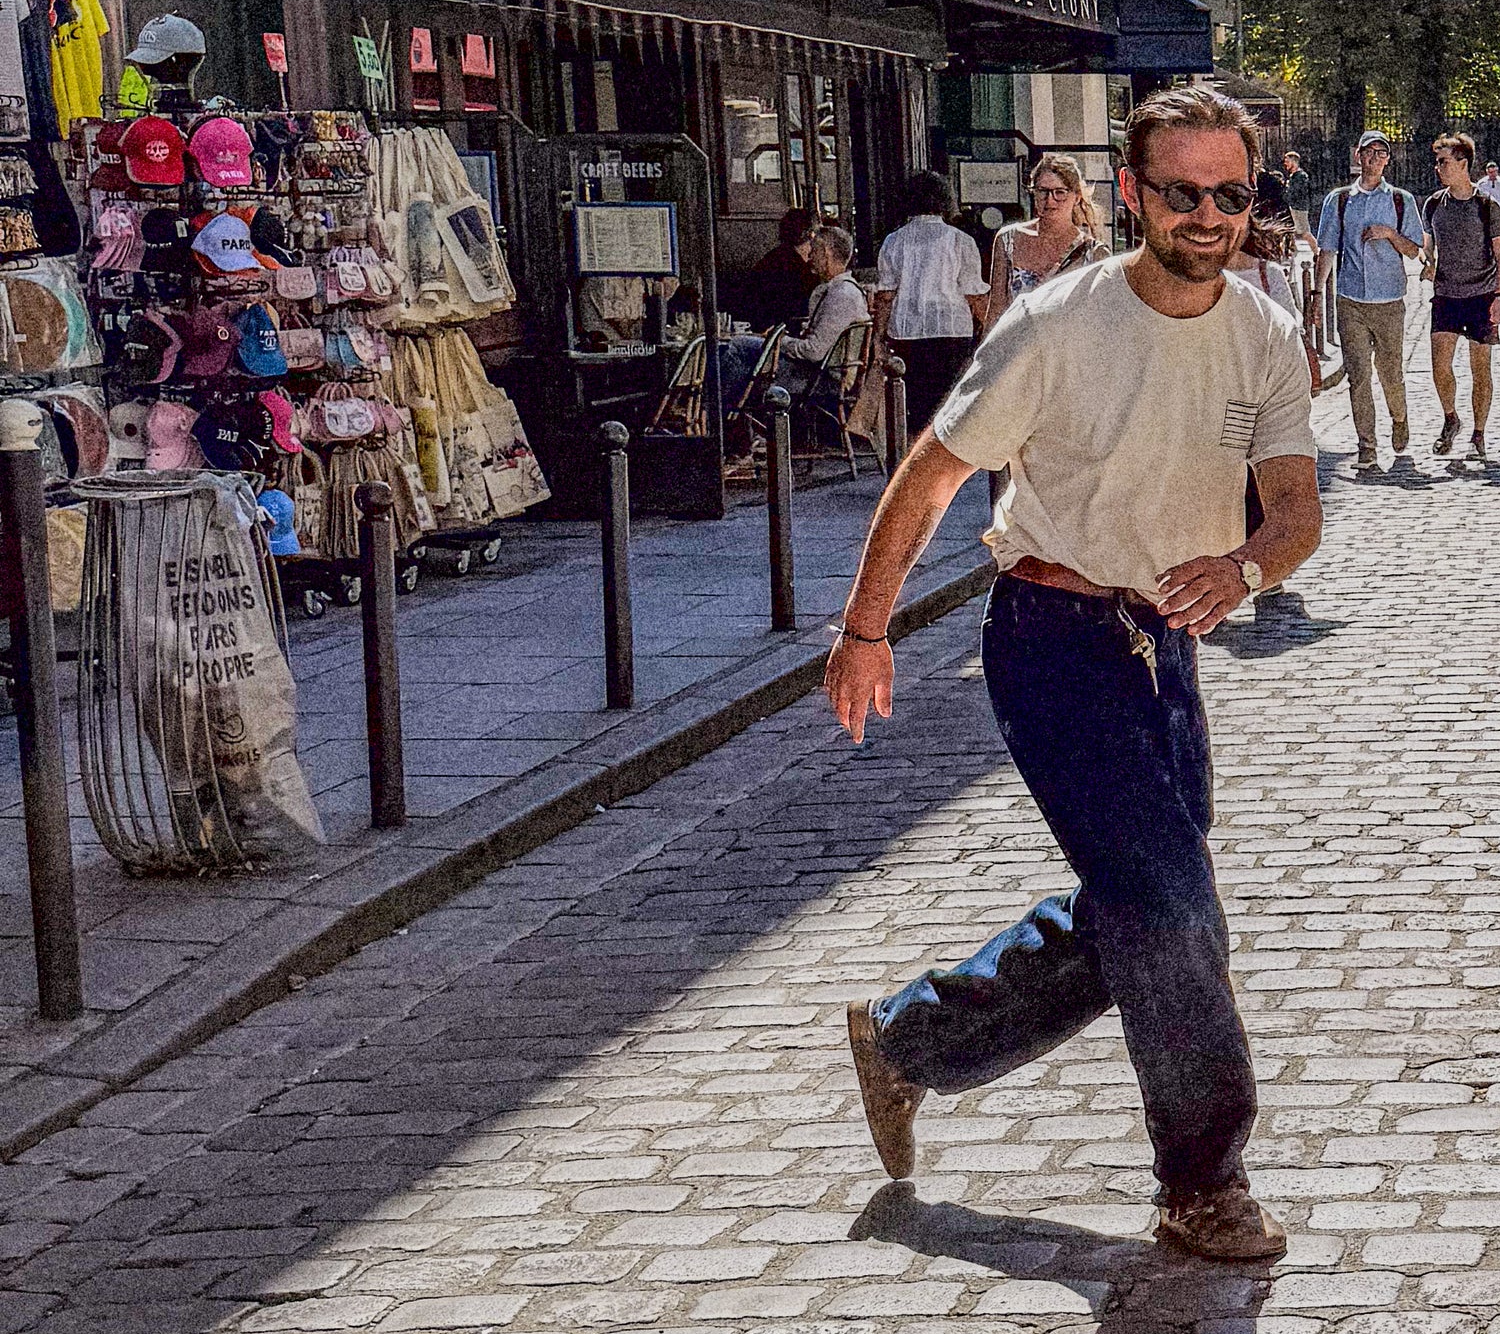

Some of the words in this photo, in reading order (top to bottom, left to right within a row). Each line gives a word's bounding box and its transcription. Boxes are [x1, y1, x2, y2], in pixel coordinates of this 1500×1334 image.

[581, 163, 619, 178] CRAFT
[623, 162, 663, 178] BEERS
[182, 652, 254, 686] PROPRE
